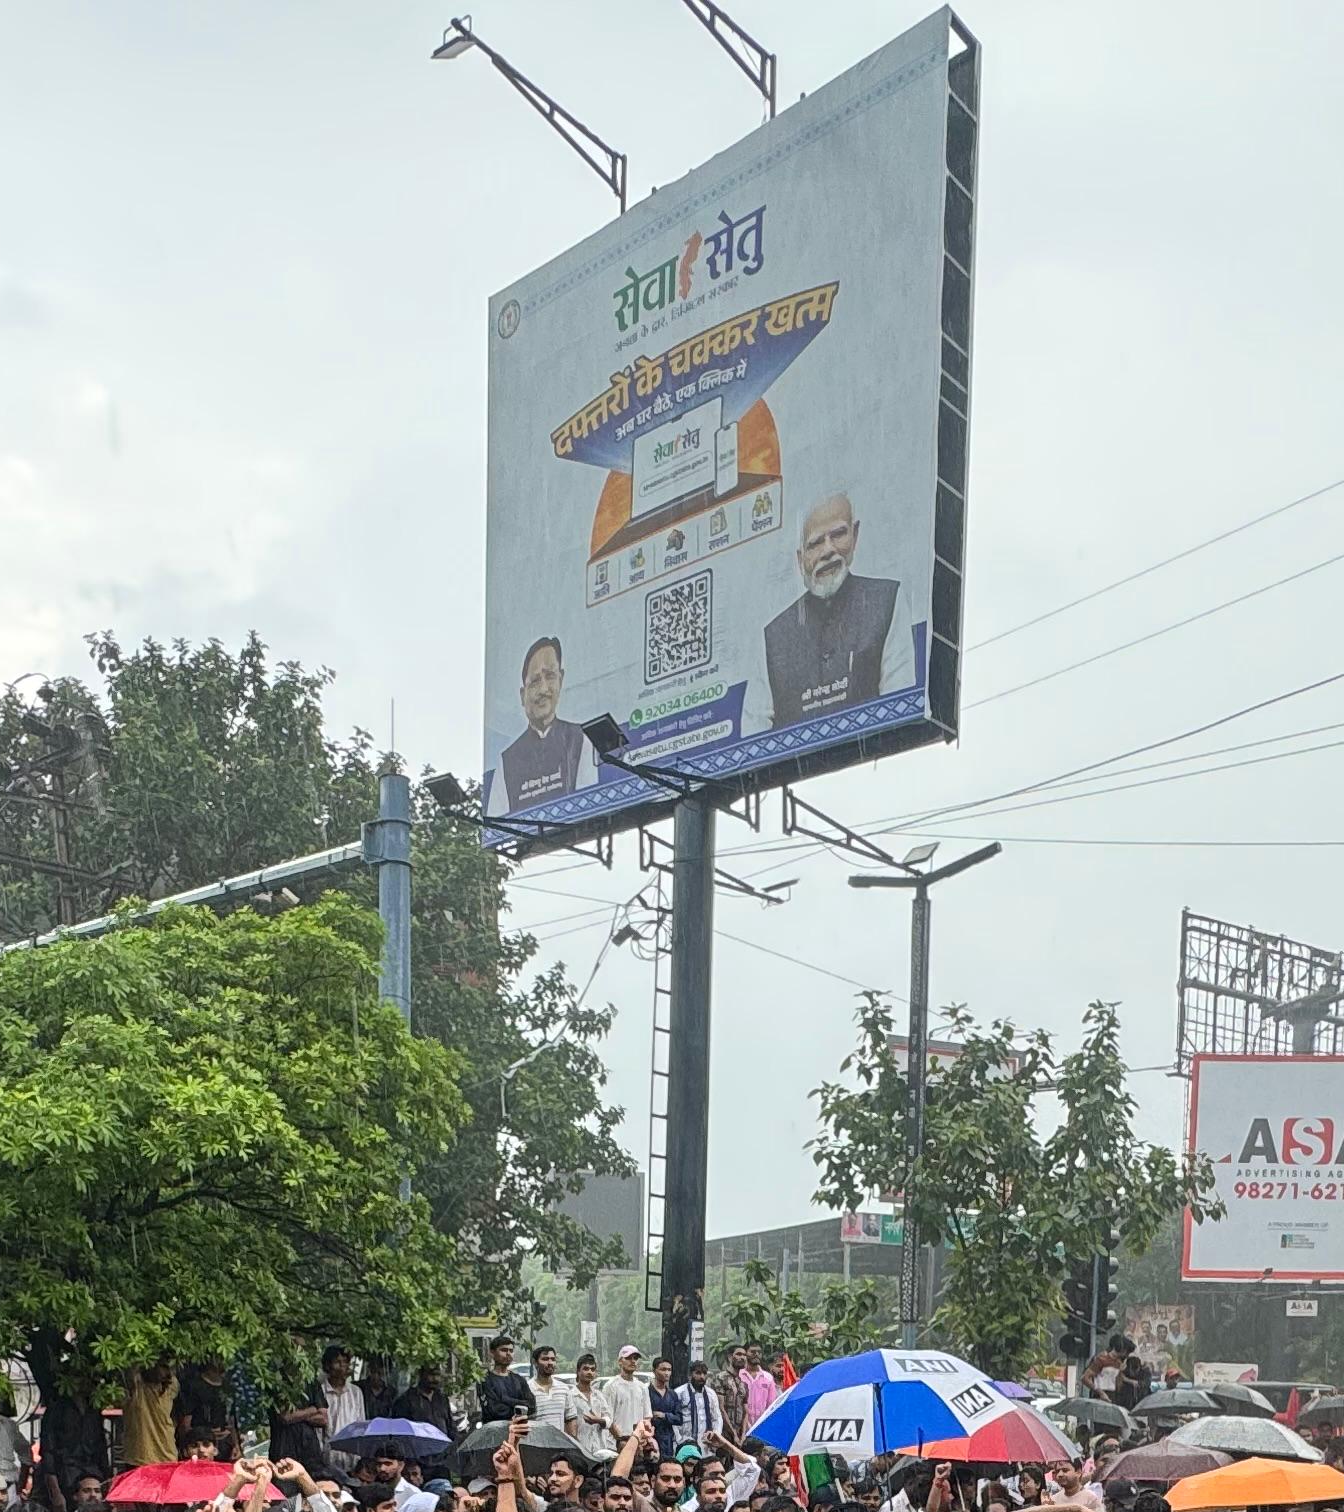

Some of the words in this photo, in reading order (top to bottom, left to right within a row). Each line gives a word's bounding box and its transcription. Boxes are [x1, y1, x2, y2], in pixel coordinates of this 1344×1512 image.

[613, 266, 679, 332] सेवा
[704, 204, 767, 280] सेतु
[551, 367, 632, 456] दफ्तरों
[636, 356, 664, 397] के
[668, 312, 760, 376] चक्कर
[765, 283, 838, 336] खत्म
[615, 418, 635, 442] अब
[675, 383, 696, 403] एक
[736, 357, 748, 380] में
[645, 698, 681, 720] 92034
[683, 684, 724, 707] 06400
[1236, 1169, 1321, 1178] ADVERTISING
[903, 1359, 955, 1373] ANI
